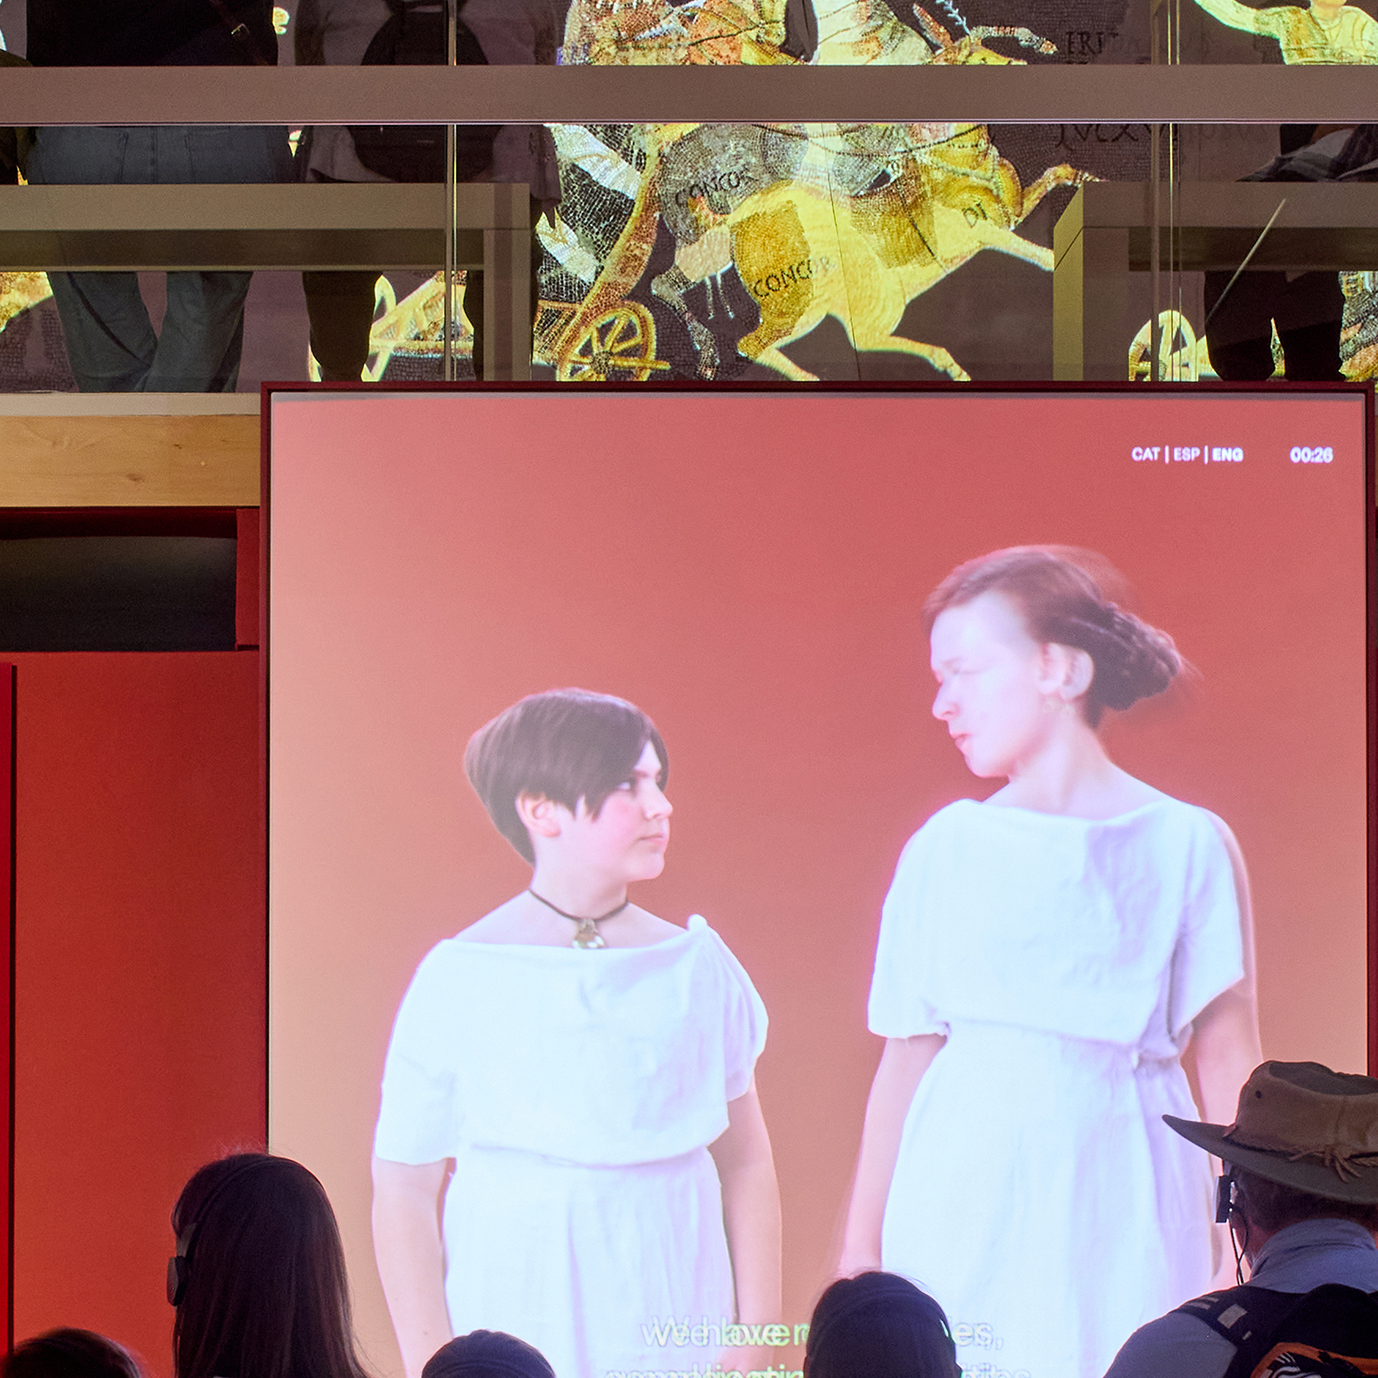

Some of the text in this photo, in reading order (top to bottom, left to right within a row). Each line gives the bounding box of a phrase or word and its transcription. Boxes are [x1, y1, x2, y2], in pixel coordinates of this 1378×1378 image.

[1131, 446, 1244, 463] CAT ESP ENG
[1289, 446, 1334, 464] 00:26
